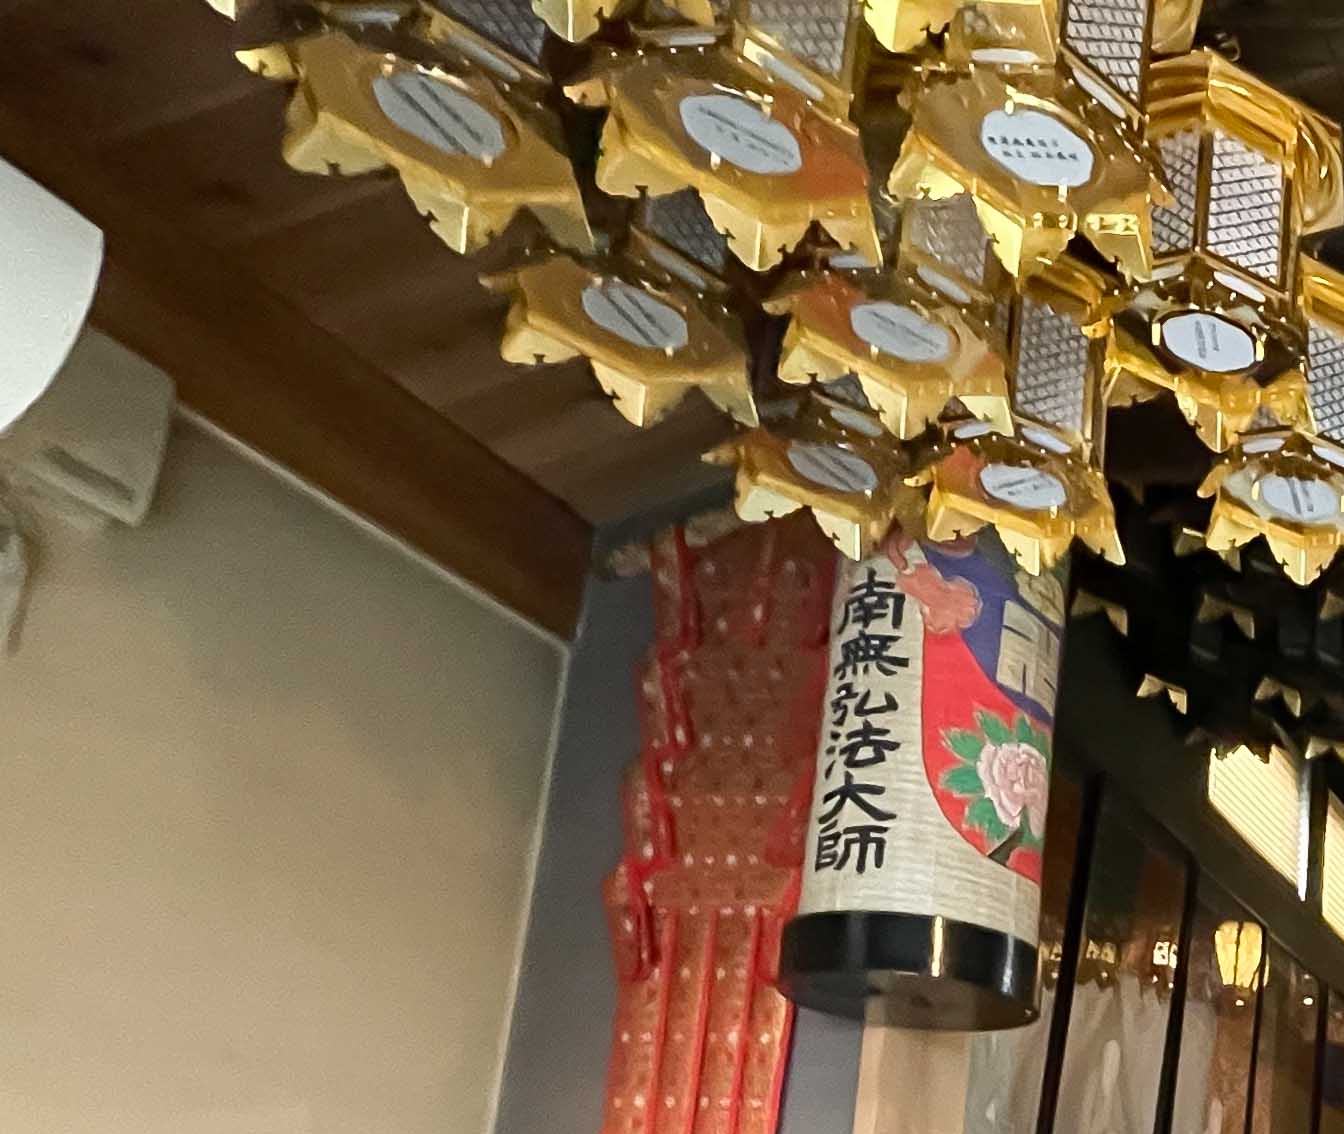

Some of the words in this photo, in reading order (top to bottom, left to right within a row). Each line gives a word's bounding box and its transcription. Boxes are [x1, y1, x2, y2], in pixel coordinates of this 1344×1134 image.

[815, 567, 909, 875] 南無弘法大師
